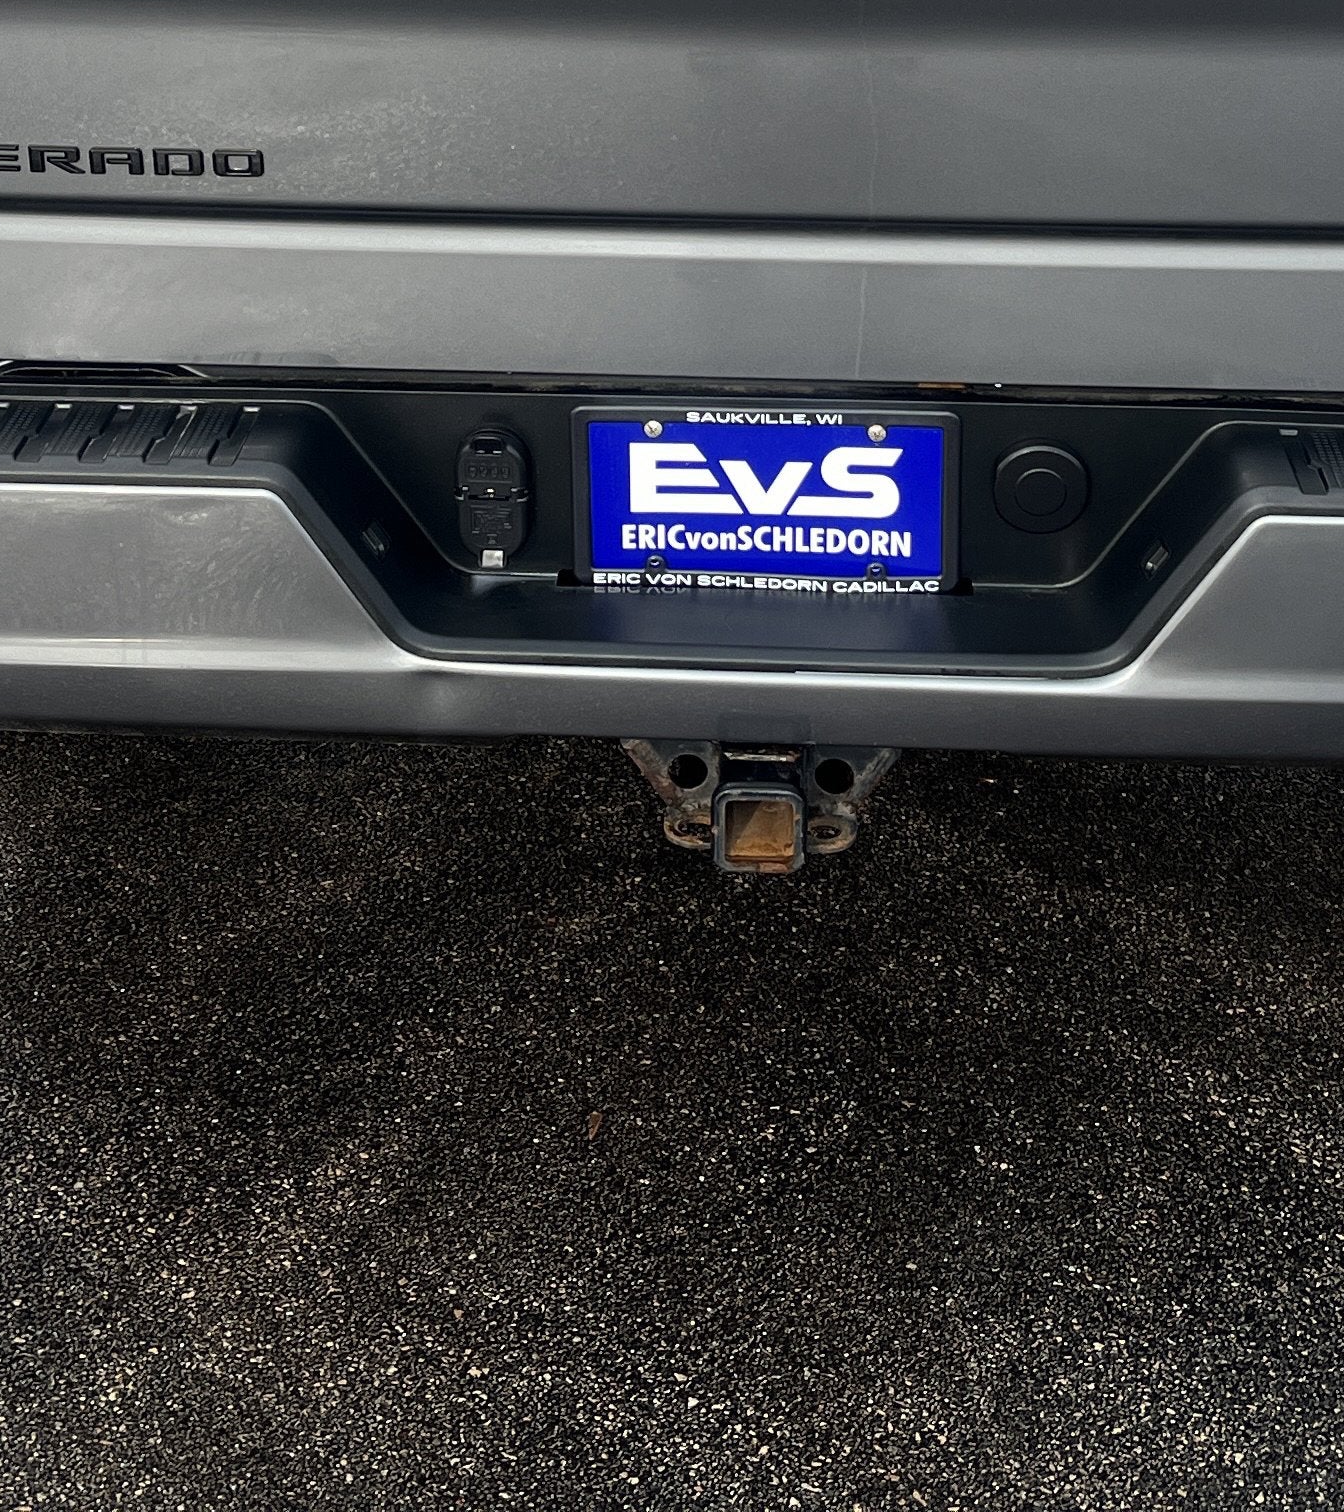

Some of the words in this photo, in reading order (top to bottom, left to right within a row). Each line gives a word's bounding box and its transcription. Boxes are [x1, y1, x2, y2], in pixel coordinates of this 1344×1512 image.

[686, 411, 811, 426] SAUKVILLE,
[815, 412, 843, 425] WI
[621, 523, 912, 557] ERICvonSCHLEDORN
[593, 572, 641, 586] ERIC
[645, 573, 693, 587] VON
[697, 576, 827, 592] SCHLEDORN
[832, 580, 940, 594] CADILLAC
